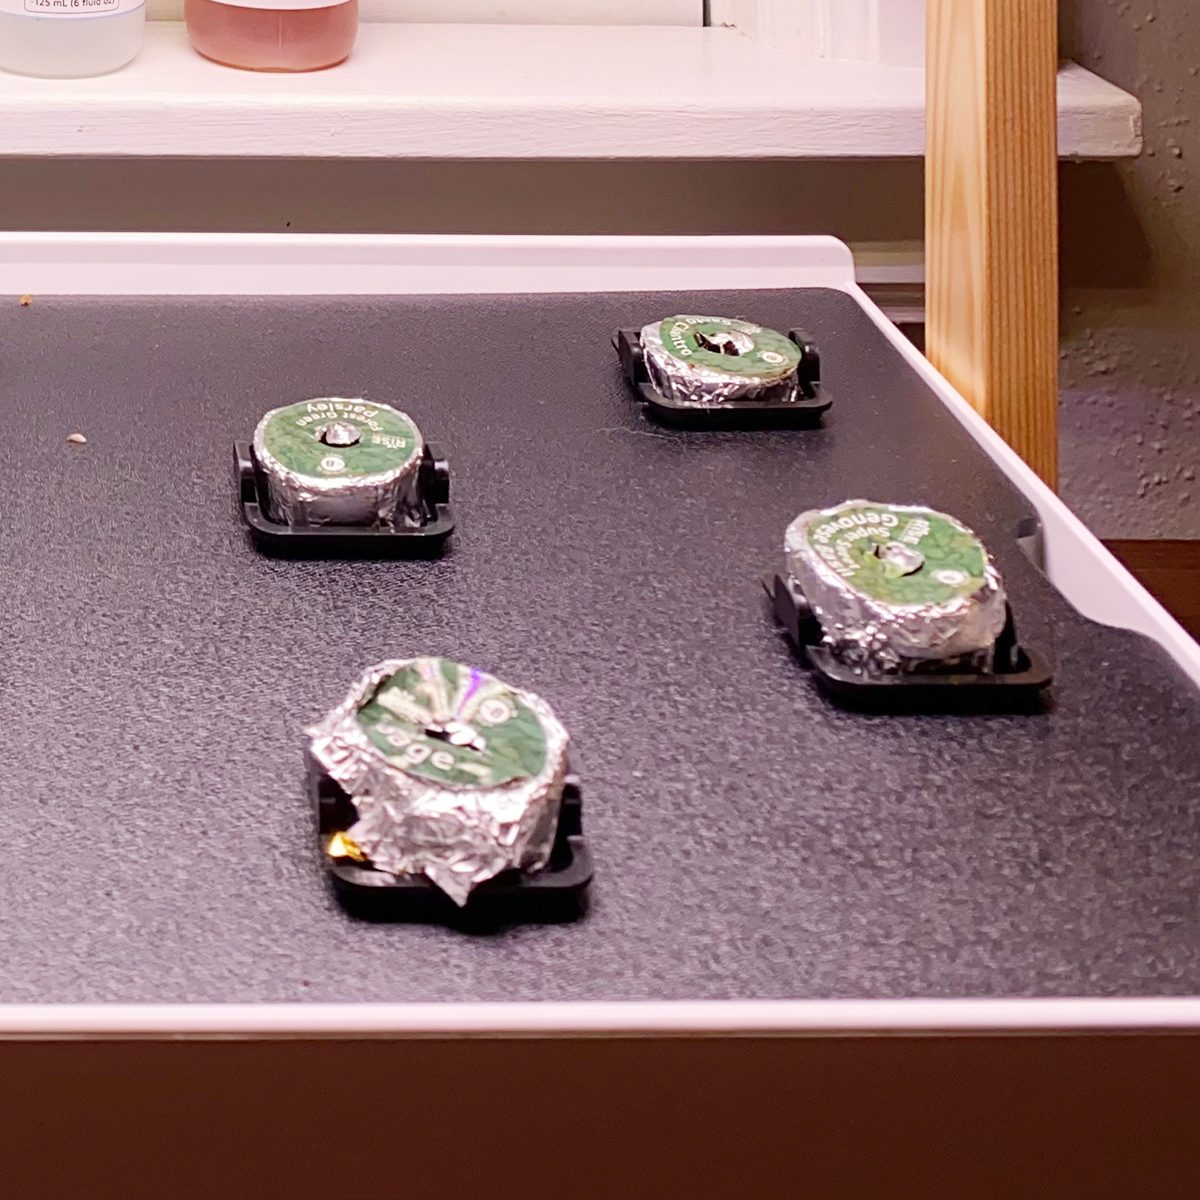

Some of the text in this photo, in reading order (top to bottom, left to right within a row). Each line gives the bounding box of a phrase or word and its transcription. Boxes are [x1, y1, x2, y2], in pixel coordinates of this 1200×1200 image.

[306, 402, 379, 418] Parsley
[295, 411, 384, 432] Forest Green
[812, 513, 899, 544] Genovese
[846, 525, 891, 542] Super
